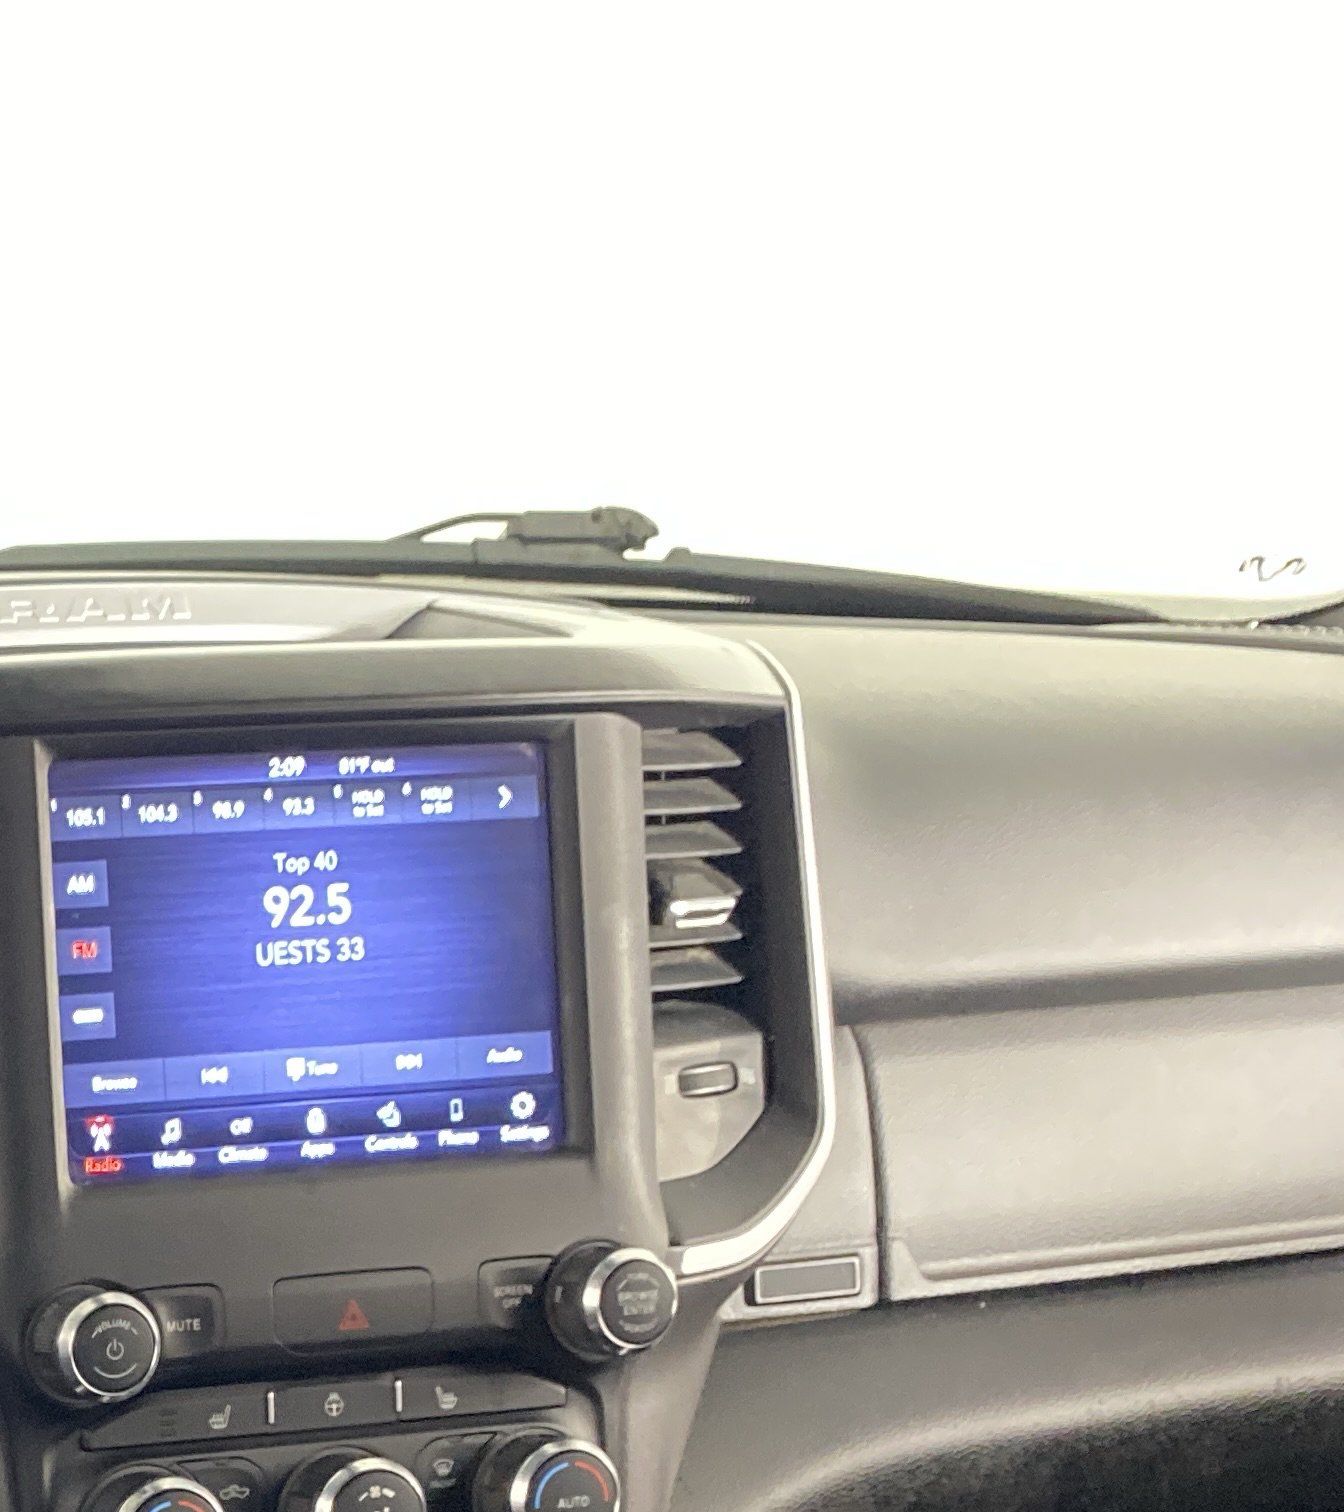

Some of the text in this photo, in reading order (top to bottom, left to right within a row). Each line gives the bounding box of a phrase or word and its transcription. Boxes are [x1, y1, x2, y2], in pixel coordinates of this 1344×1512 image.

[273, 850, 338, 876] Top 40
[67, 874, 95, 895] AM
[263, 882, 353, 929] 92.5
[71, 939, 97, 960] FM
[255, 936, 366, 968] UESTS 33
[84, 1156, 124, 1175] Radio
[95, 1318, 132, 1334] VOLUME
[166, 1318, 202, 1333] MUTE
[557, 1495, 591, 1510] AUTO
